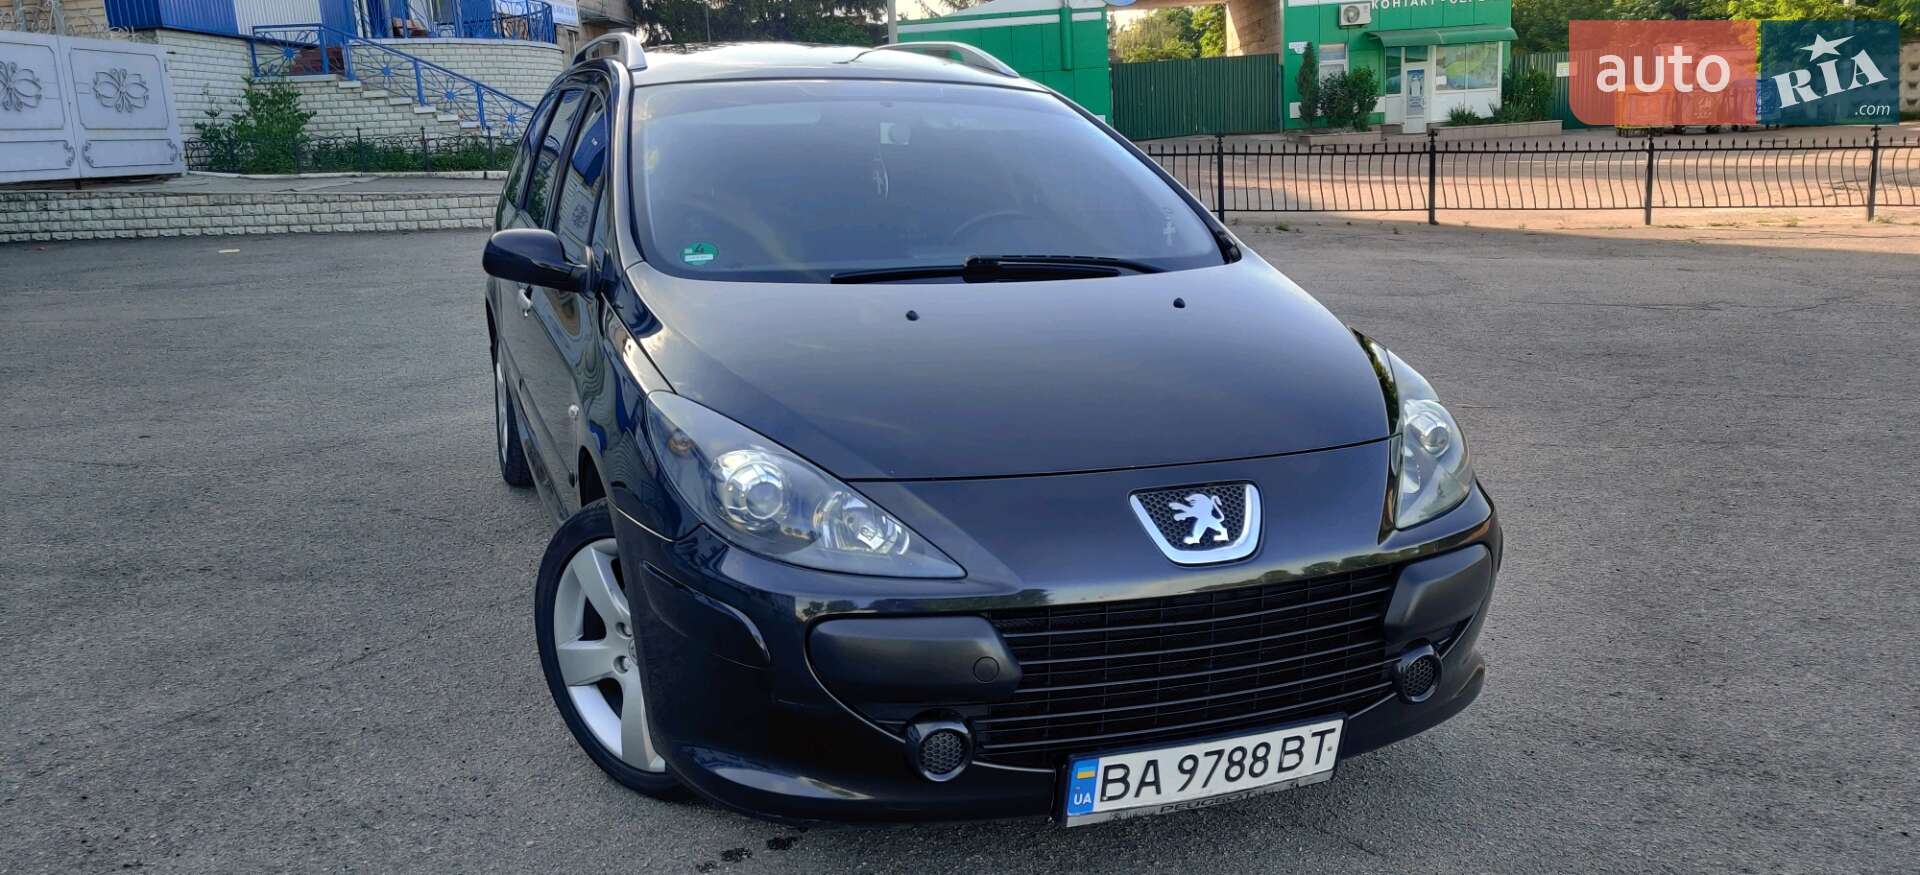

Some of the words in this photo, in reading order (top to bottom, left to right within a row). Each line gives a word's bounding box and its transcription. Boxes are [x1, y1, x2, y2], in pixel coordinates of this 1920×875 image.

[1100, 759, 1162, 802] BA
[1177, 741, 1272, 792] 9788
[1277, 728, 1337, 774] BT
[1074, 793, 1091, 806] UA
